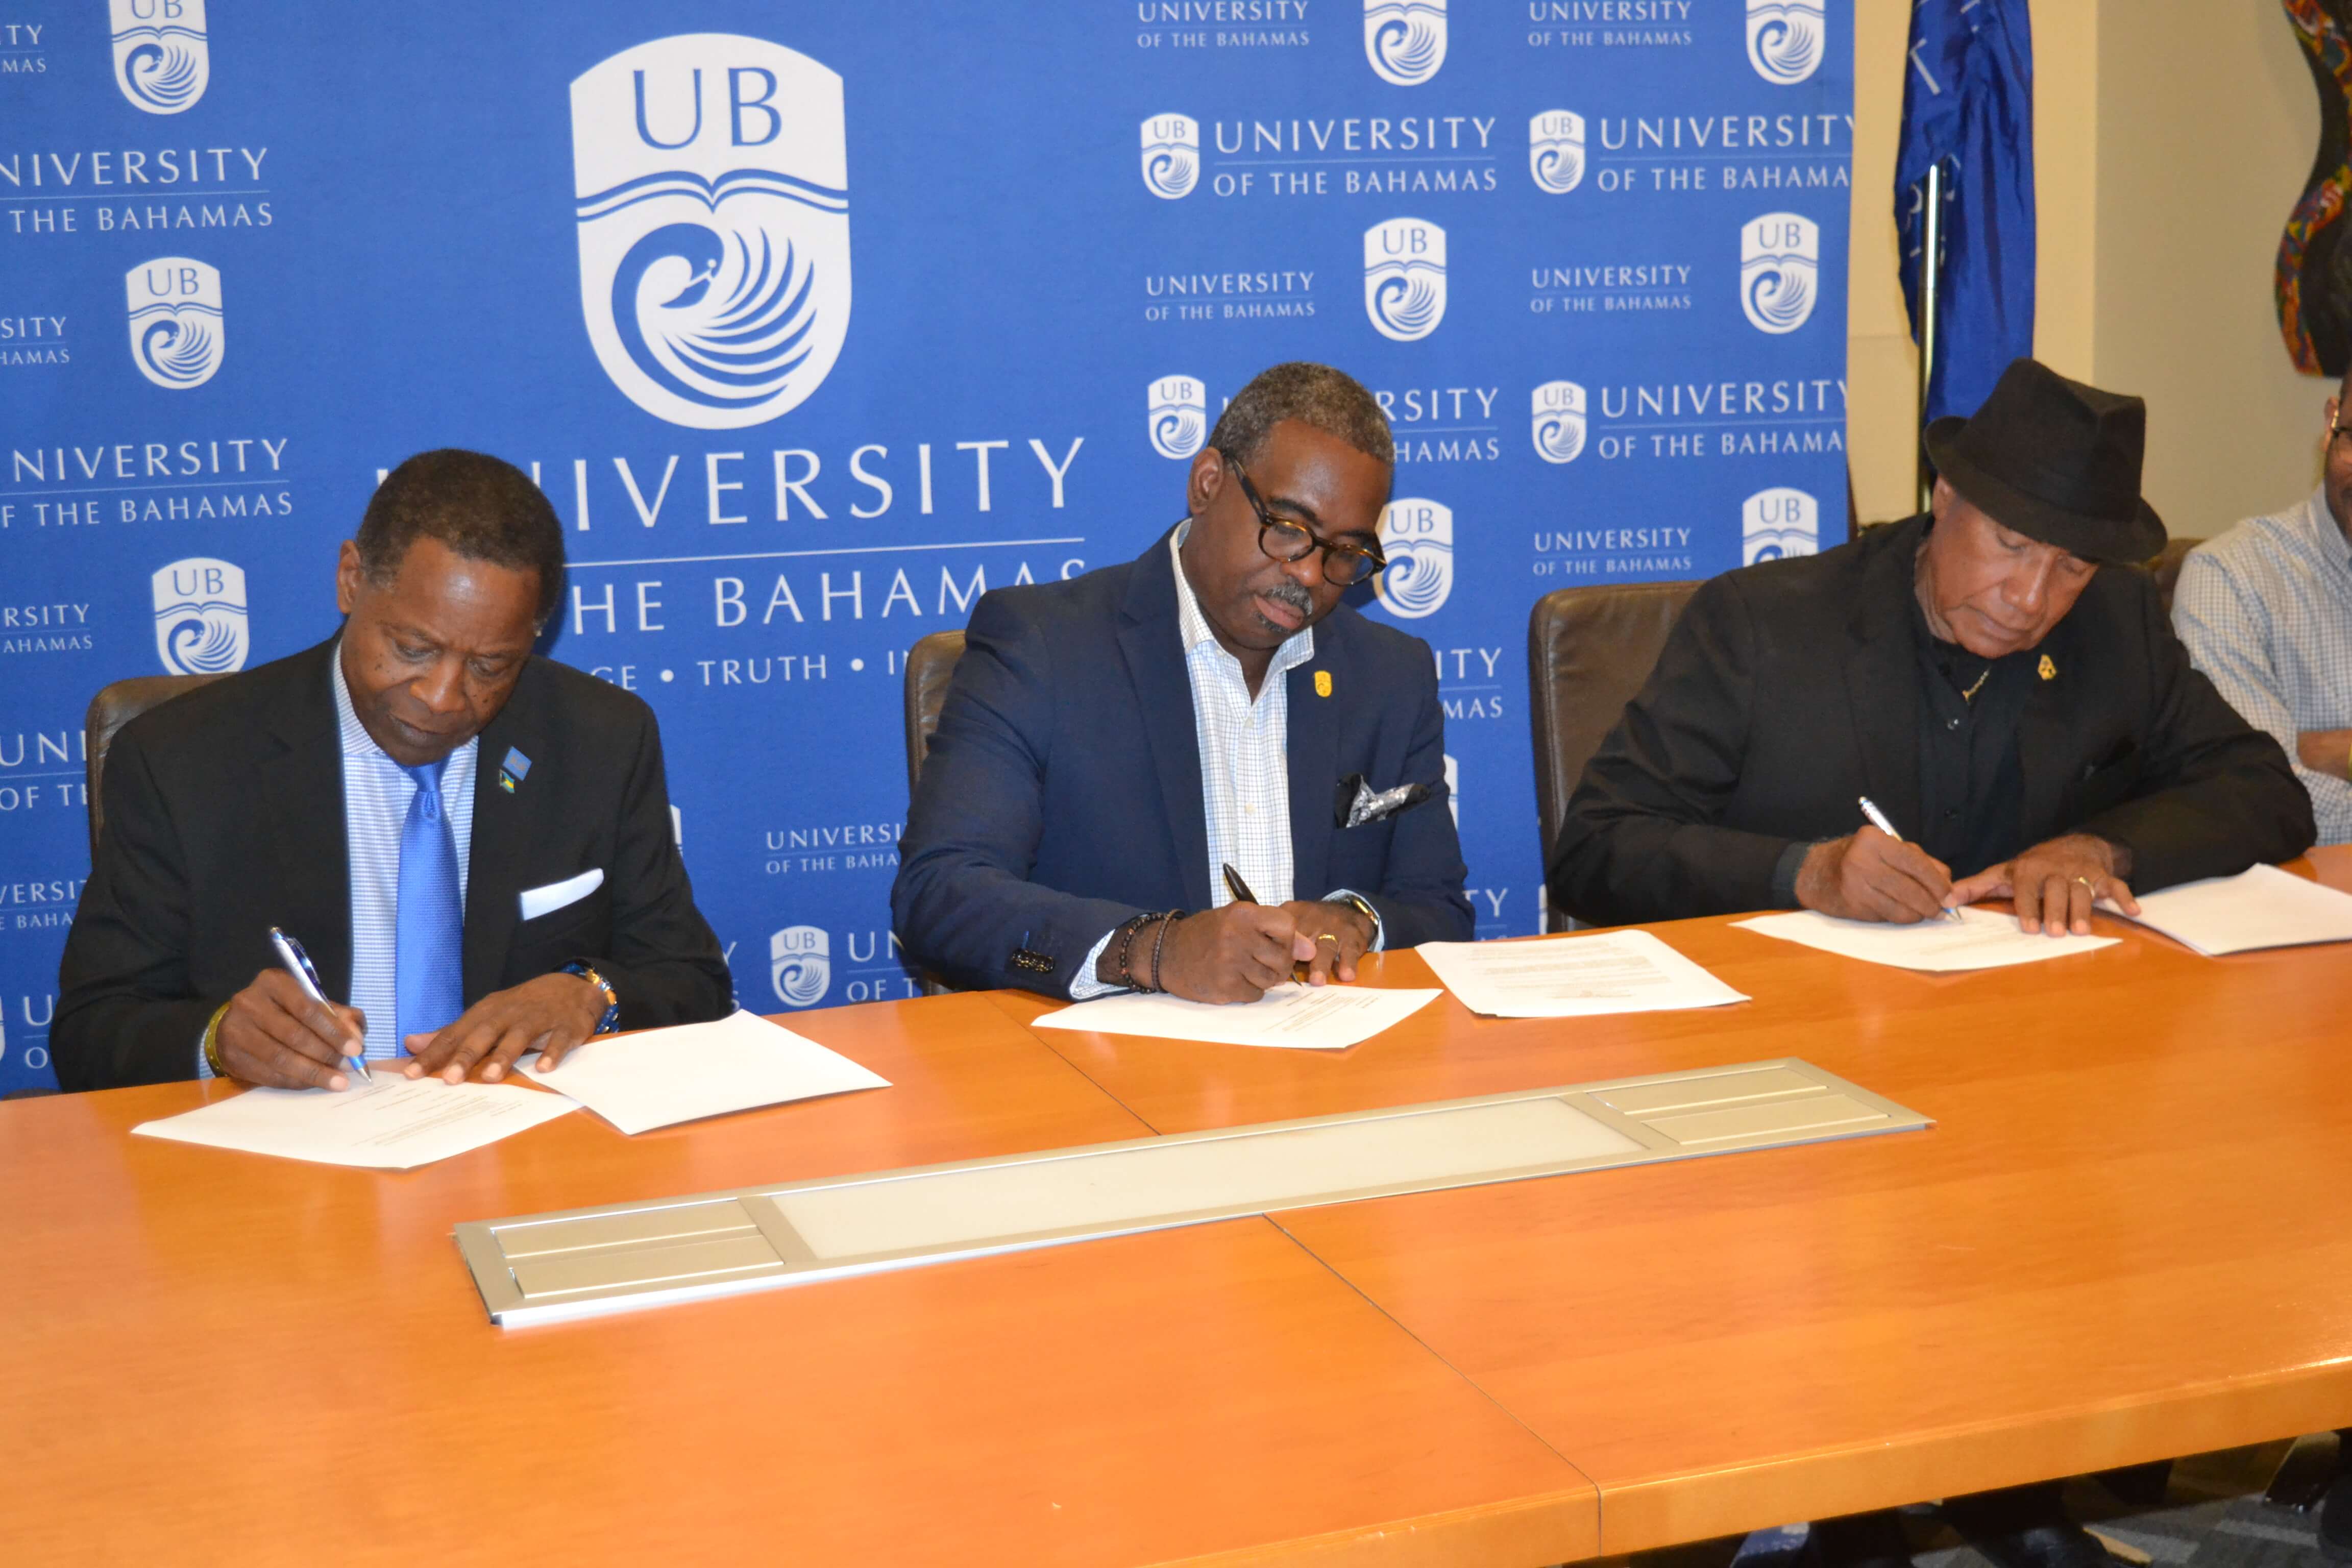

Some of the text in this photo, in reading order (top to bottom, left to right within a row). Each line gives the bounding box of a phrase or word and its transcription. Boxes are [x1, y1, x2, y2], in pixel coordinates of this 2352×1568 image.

[131, 0, 183, 19] UB
[1139, 0, 1307, 22] UNIVERSITY
[1530, 1, 1691, 21] UNIVERSITY
[1137, 32, 1309, 47] OF THE BAHAMAS
[1528, 32, 1691, 46] OF THE BAHAMAS
[633, 67, 782, 150] UB
[1154, 120, 1186, 139] UB
[1216, 117, 1495, 154] UNIVERSITY
[1541, 117, 1573, 136] UB
[1213, 168, 1497, 197] OF THE BAHAMAS
[1598, 169, 1634, 191] OF
[1651, 168, 1705, 190] THE
[9, 203, 272, 233] THE BAHAMAS
[1382, 228, 1427, 255] UB
[1758, 223, 1801, 249] UB
[146, 267, 199, 297] UB
[1146, 272, 1313, 296] UNIVERSITY
[1532, 265, 1690, 288] UNIVERSITY
[1145, 303, 1315, 321] OF THE BAHAMAS
[1530, 297, 1691, 312] OF THE BAHAMAS
[1161, 382, 1193, 401] UB
[1544, 387, 1574, 406] UB
[1599, 436, 1635, 459] OF
[1651, 434, 1703, 457] THE
[33, 501, 100, 526] THE
[121, 492, 292, 522] BAHAMAS
[1759, 498, 1801, 524] UB
[1390, 508, 1434, 534] UB
[1535, 528, 1689, 552] UNIVERSITY
[1533, 557, 1691, 575] OF THE BAHAMAS
[173, 568, 224, 596] UB
[697, 654, 826, 686] TRUTH
[0, 787, 39, 811] OF
[766, 859, 791, 874] OF
[800, 856, 836, 872] THE
[783, 932, 816, 950] UB
